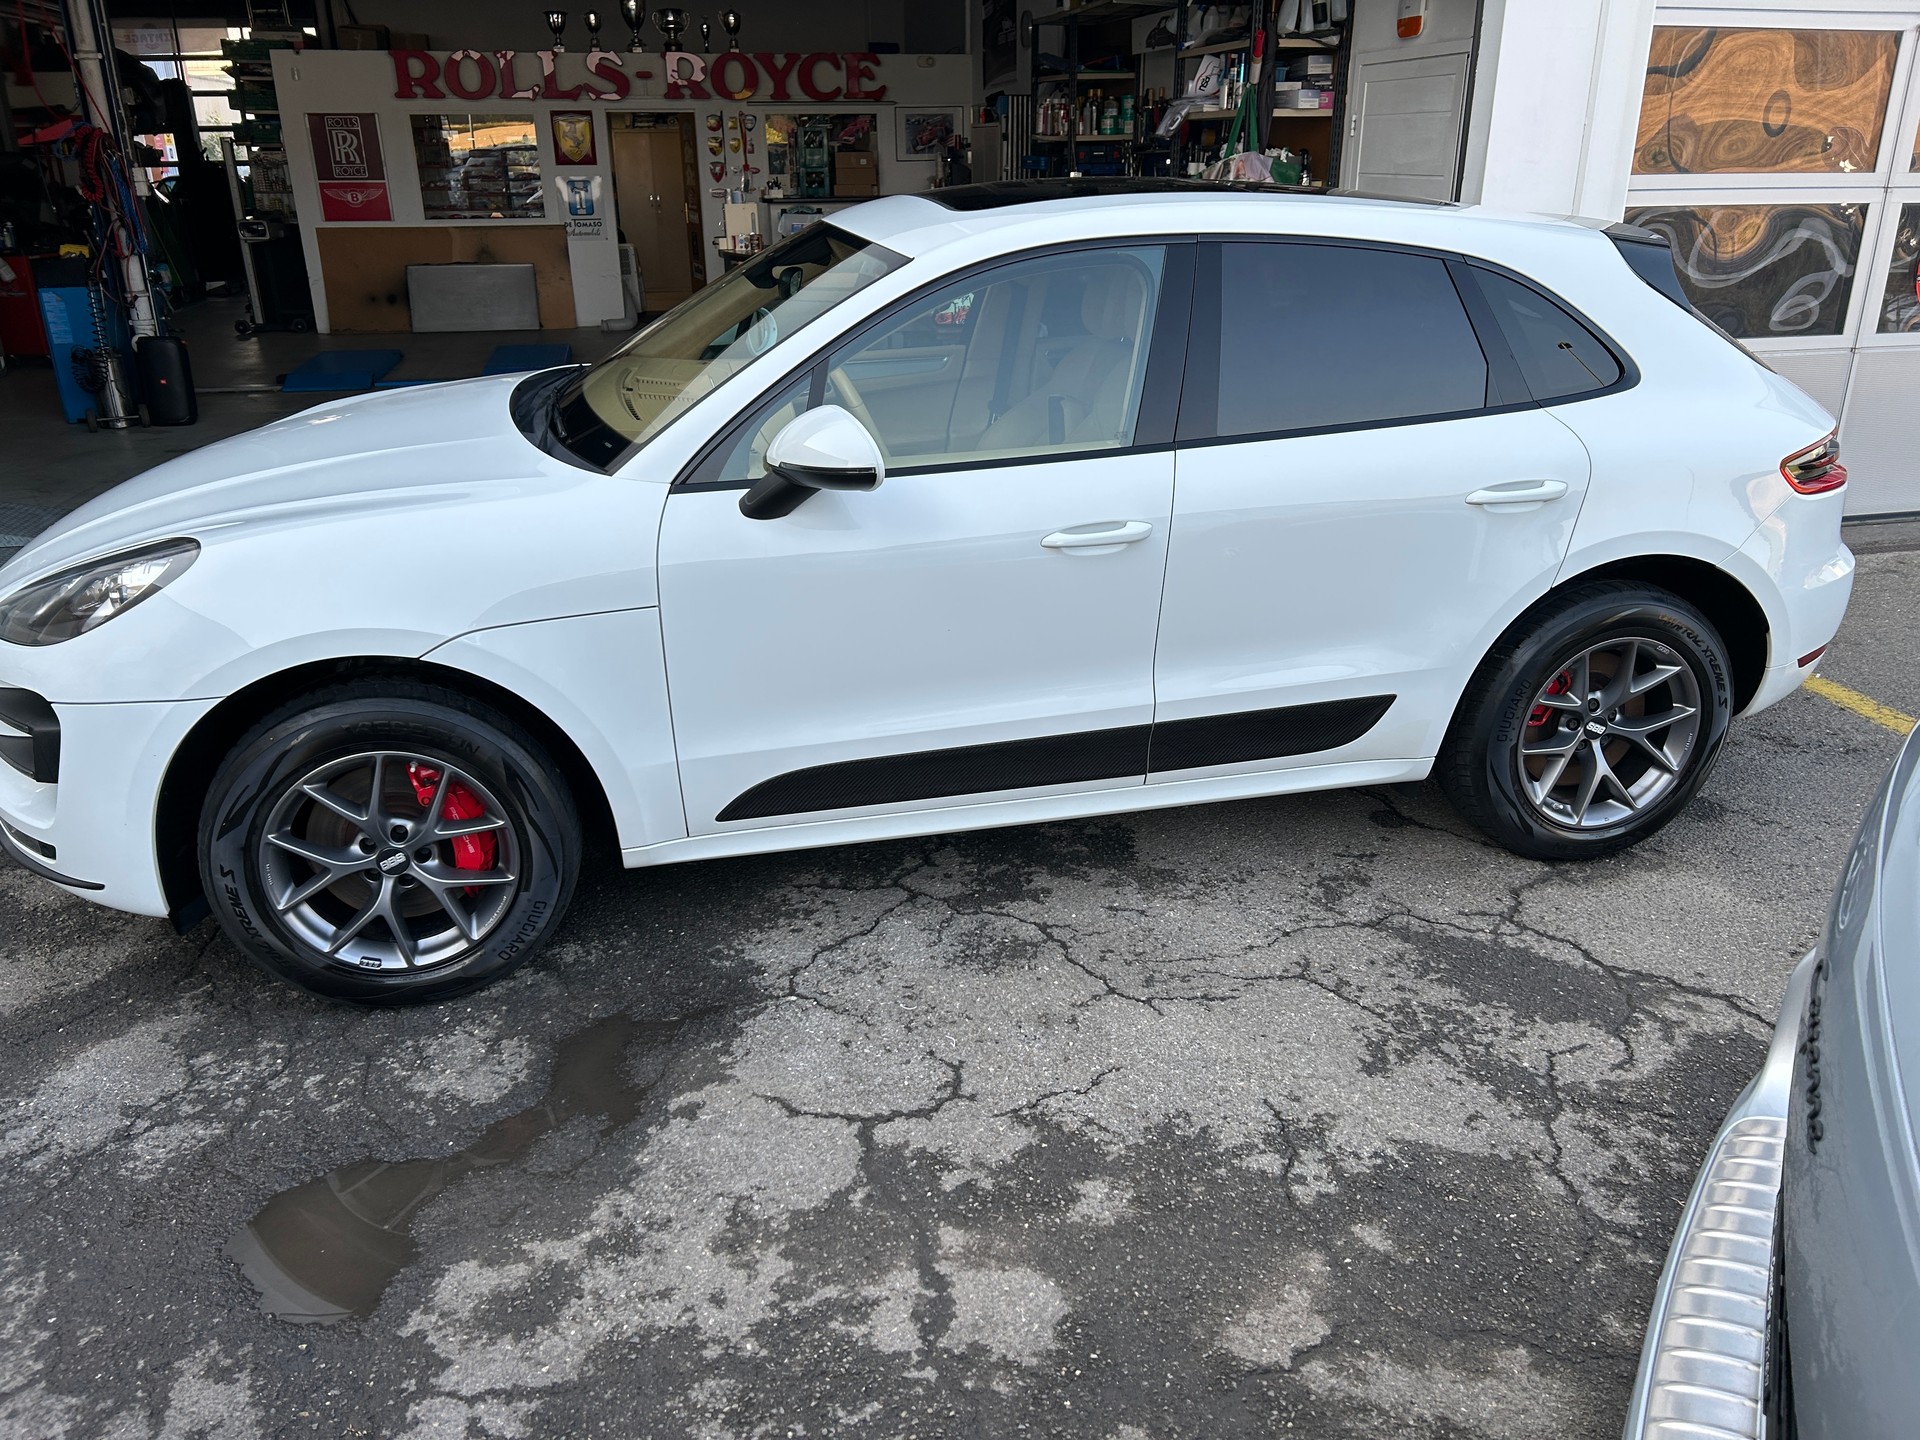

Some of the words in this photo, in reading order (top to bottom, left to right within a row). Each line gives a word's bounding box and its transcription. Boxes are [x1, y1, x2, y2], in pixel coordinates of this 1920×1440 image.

[389, 49, 886, 102] ROLLS-ROYCE
[327, 117, 358, 128] ROLLS
[335, 166, 365, 176] ROYCE
[571, 218, 603, 228] TOMASO
[1702, 645, 1726, 692] XTREME
[1496, 679, 1532, 743] GIUGIARO
[379, 852, 407, 872] BBS
[225, 884, 263, 939] XTREME
[499, 901, 547, 961] GIUGIARO
